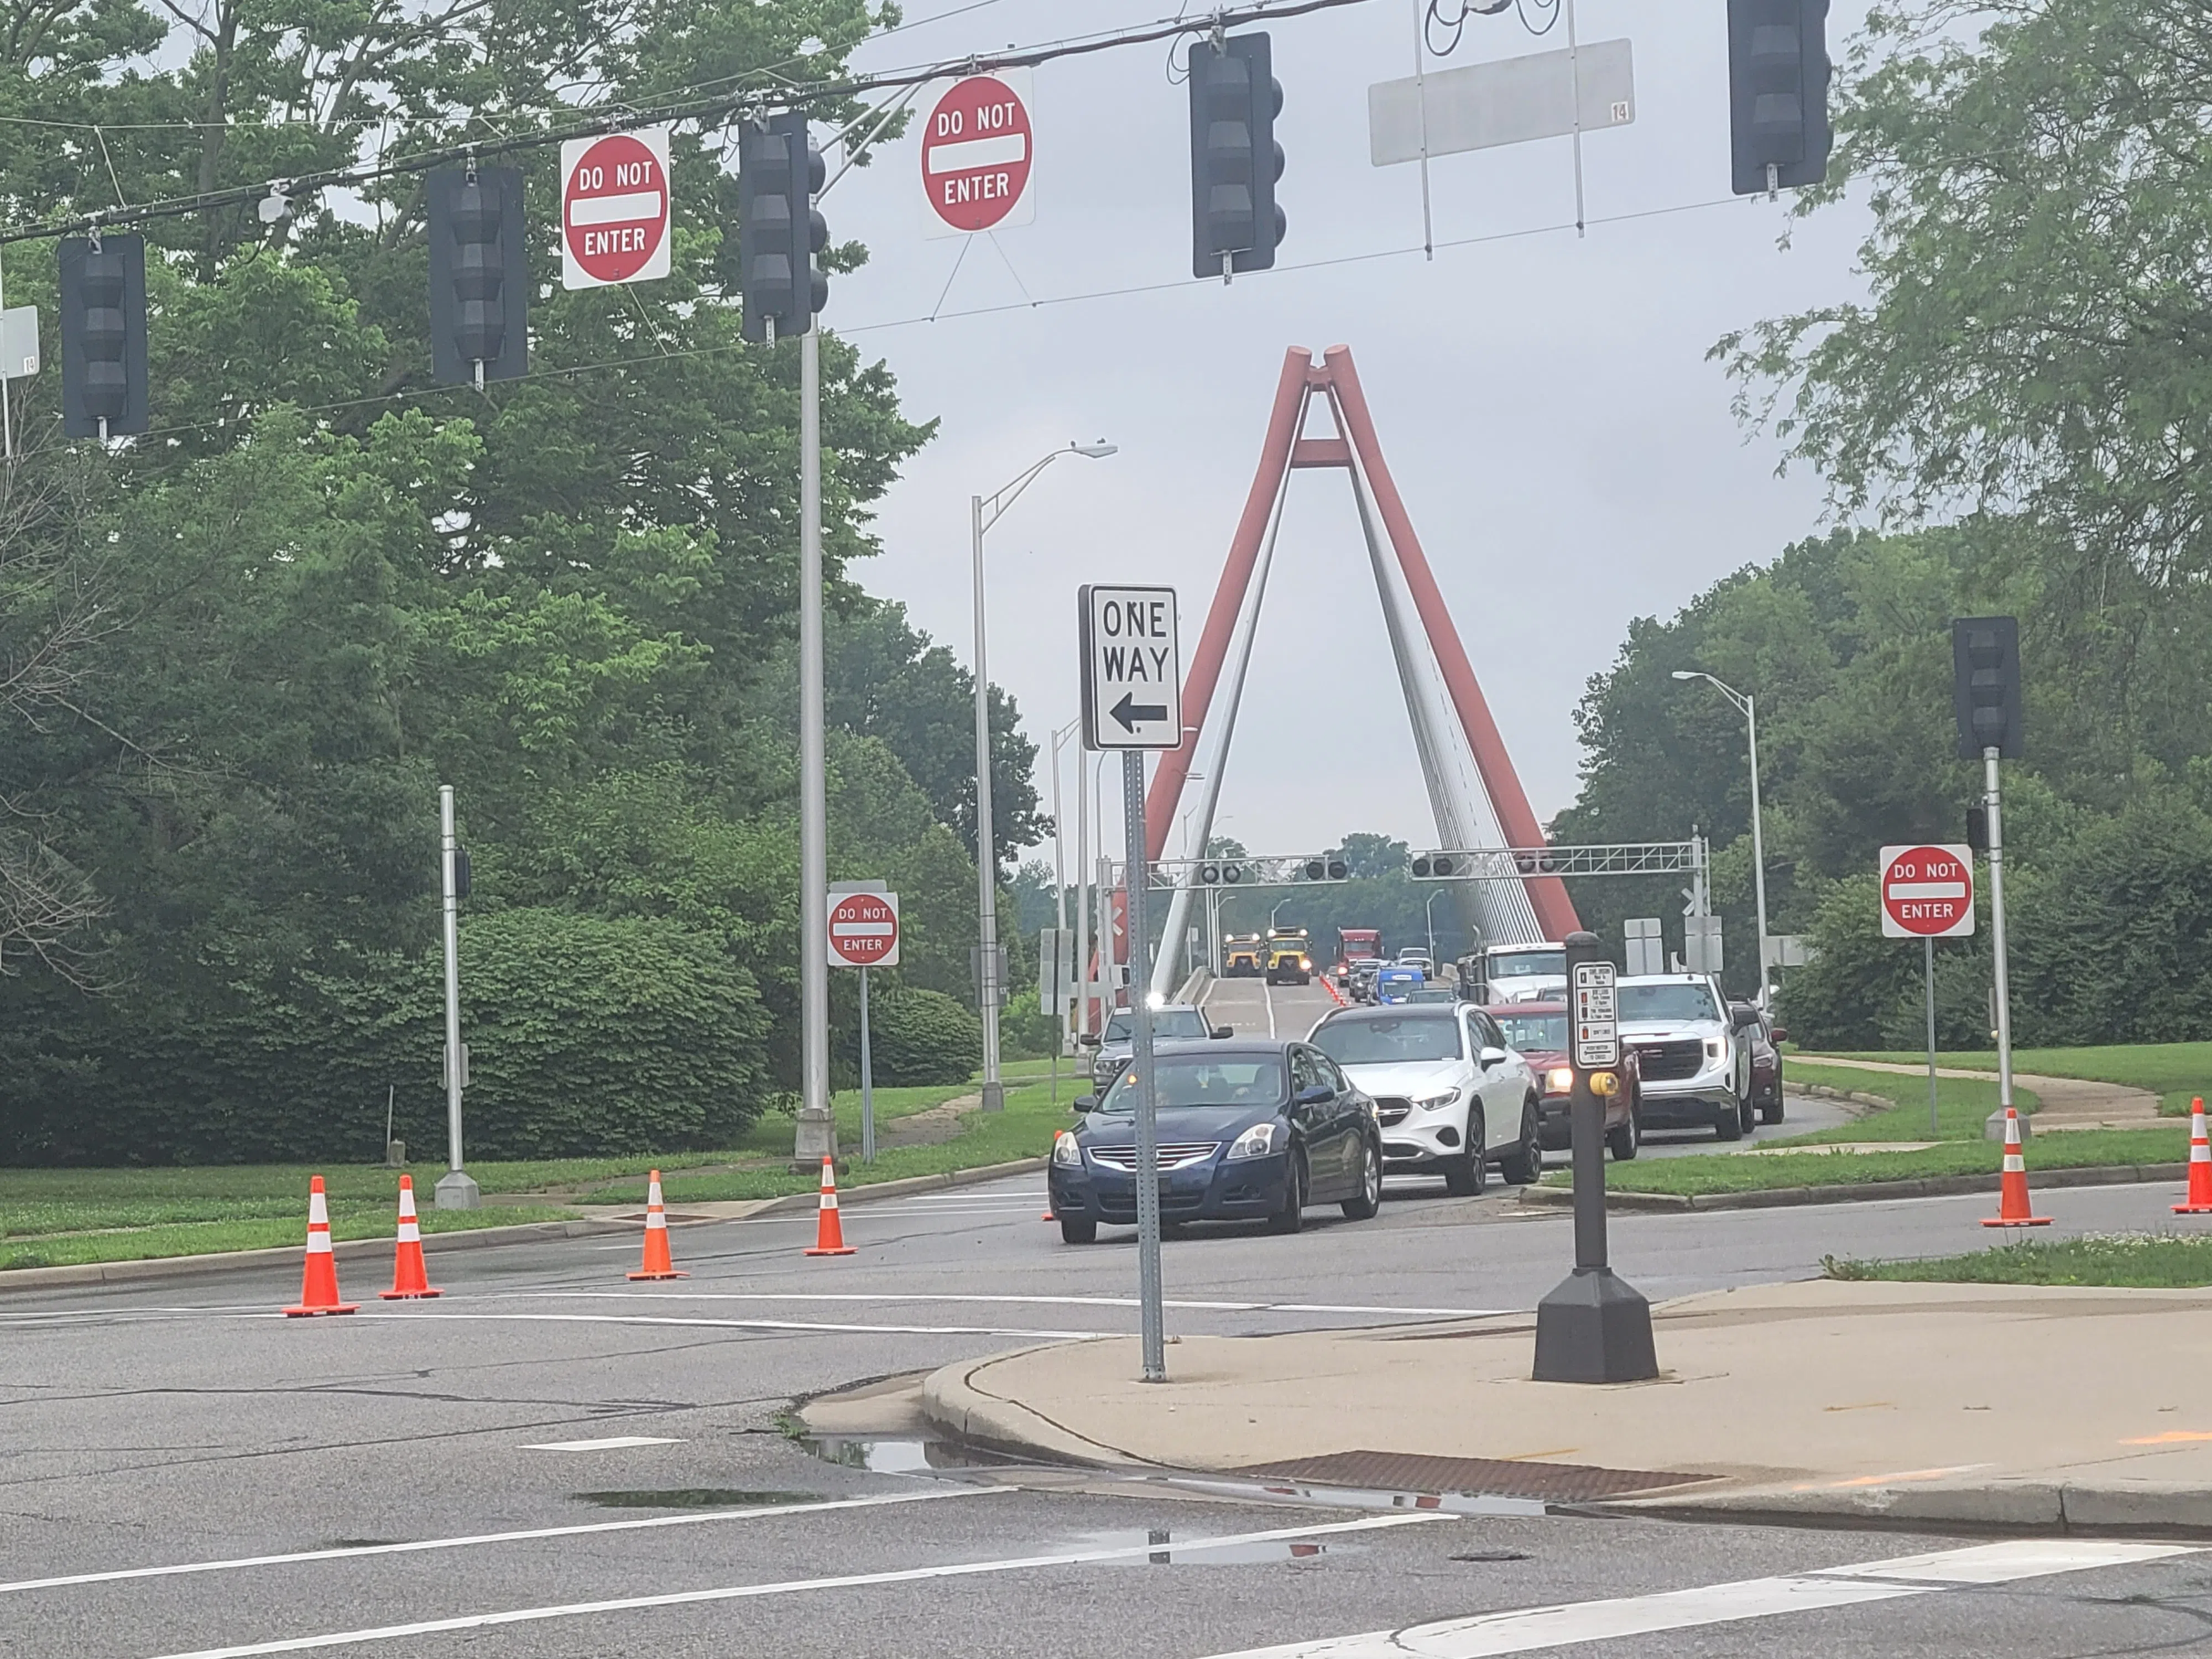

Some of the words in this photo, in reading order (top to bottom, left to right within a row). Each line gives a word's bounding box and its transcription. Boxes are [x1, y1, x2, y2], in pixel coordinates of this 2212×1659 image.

[938, 110, 963, 137] DO
[977, 102, 1015, 131] NOT
[1613, 103, 1626, 120] 14
[580, 166, 603, 191] DO
[617, 160, 653, 187] NOT
[945, 173, 1009, 205] ENTER
[585, 227, 645, 255] ENTER
[1103, 601, 1166, 637] ONE
[1103, 646, 1169, 682] WAY
[1895, 864, 1915, 878] DO
[1927, 863, 1958, 878] NOT
[839, 909, 855, 919] DO
[863, 907, 887, 919] NOT
[1902, 904, 1953, 919] ENTER
[843, 939, 882, 951] ENTER
